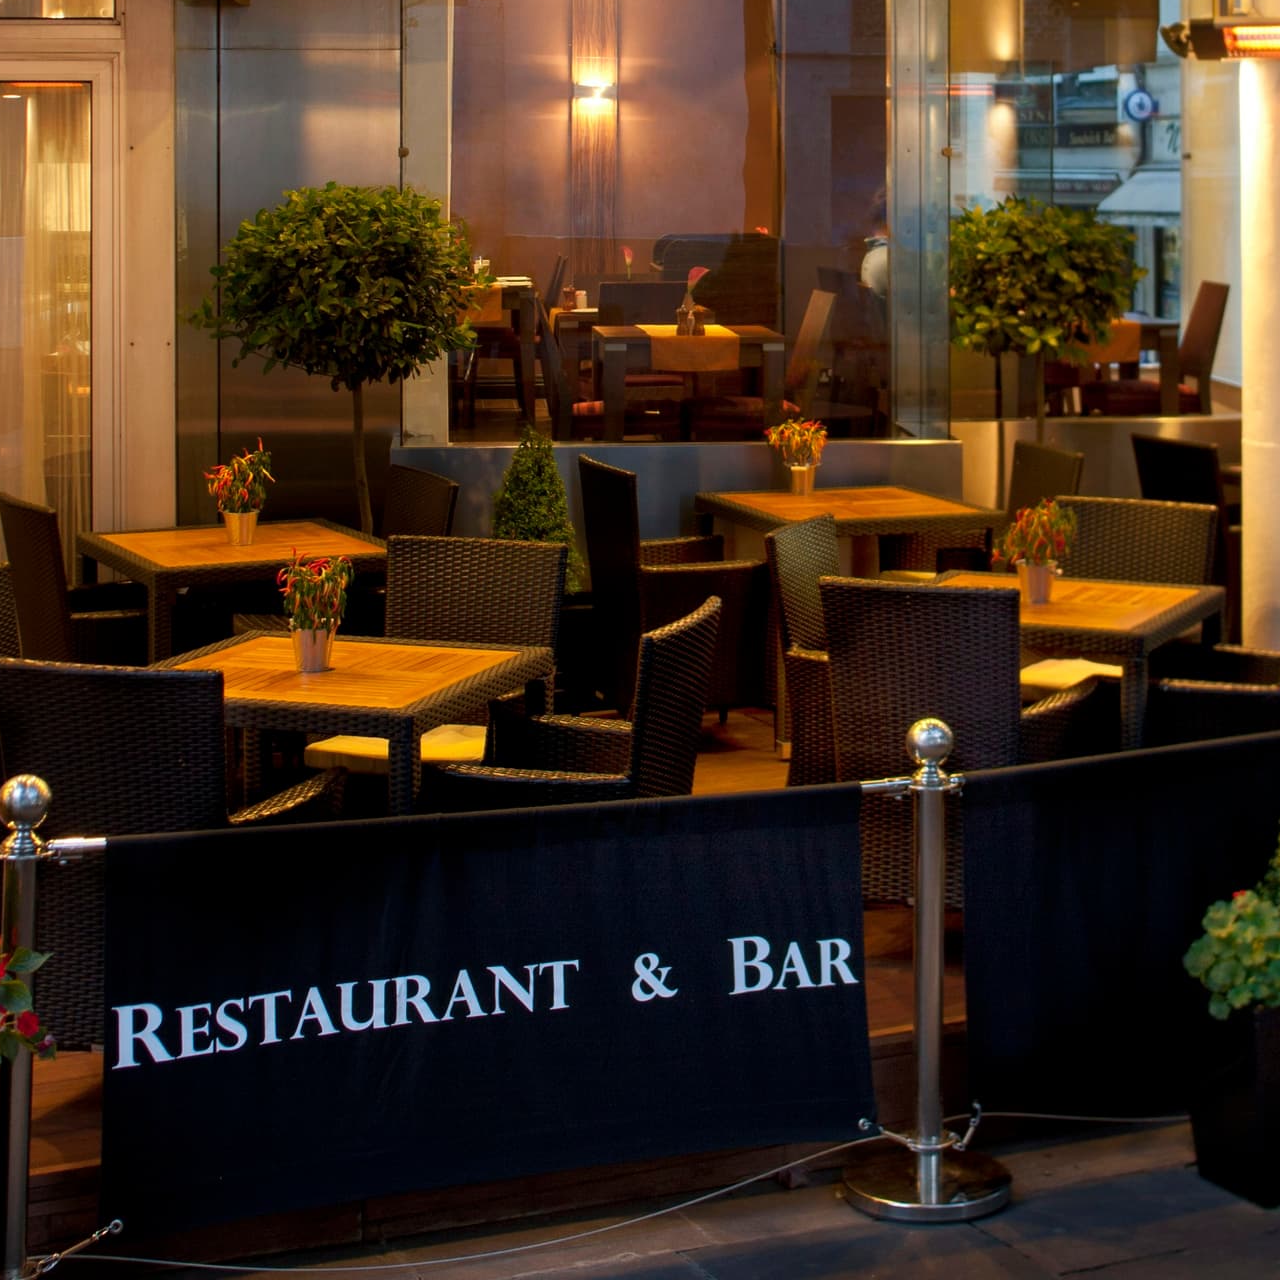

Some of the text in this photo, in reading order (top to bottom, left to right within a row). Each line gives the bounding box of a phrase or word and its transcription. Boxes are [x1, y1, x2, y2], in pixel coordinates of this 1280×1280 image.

[111, 934, 860, 1070] RESTAURANT & BAR
